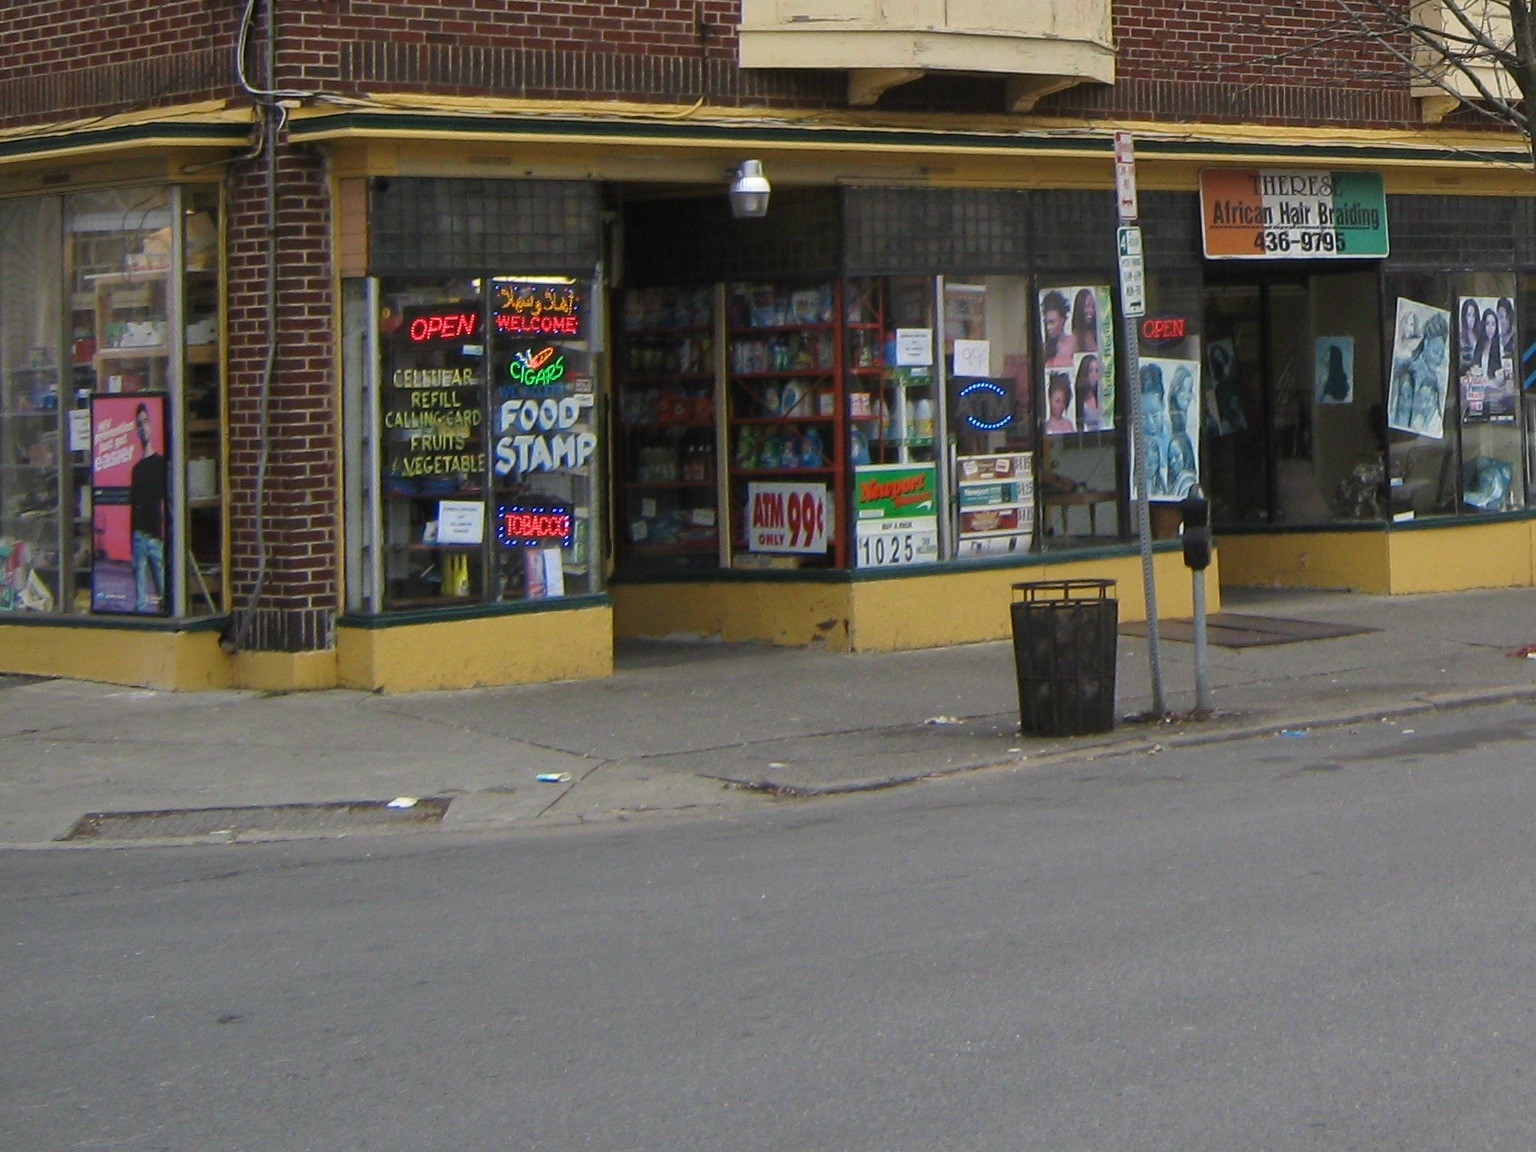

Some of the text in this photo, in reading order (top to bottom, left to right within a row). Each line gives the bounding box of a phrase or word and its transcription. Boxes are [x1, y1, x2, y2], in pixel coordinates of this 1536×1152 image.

[1250, 175, 1344, 197] THERESE
[1213, 201, 1380, 230] African Hair Braiding
[1253, 231, 1346, 252] 436-9795
[410, 313, 476, 341] OPEN
[496, 315, 577, 333] WELCOME
[1143, 320, 1185, 338] OPEN
[510, 355, 566, 386] CIGARS
[411, 391, 462, 408] REFILL
[385, 411, 440, 429] CALLING
[500, 398, 580, 434] FOOD
[410, 434, 466, 451] FRUITS
[403, 454, 487, 476] VEGETABLE
[495, 432, 598, 477] STAMP
[860, 472, 926, 504] Newport
[505, 514, 571, 537] TOBACCO
[753, 491, 824, 547] ATM 99¢
[758, 533, 785, 546] ONLY
